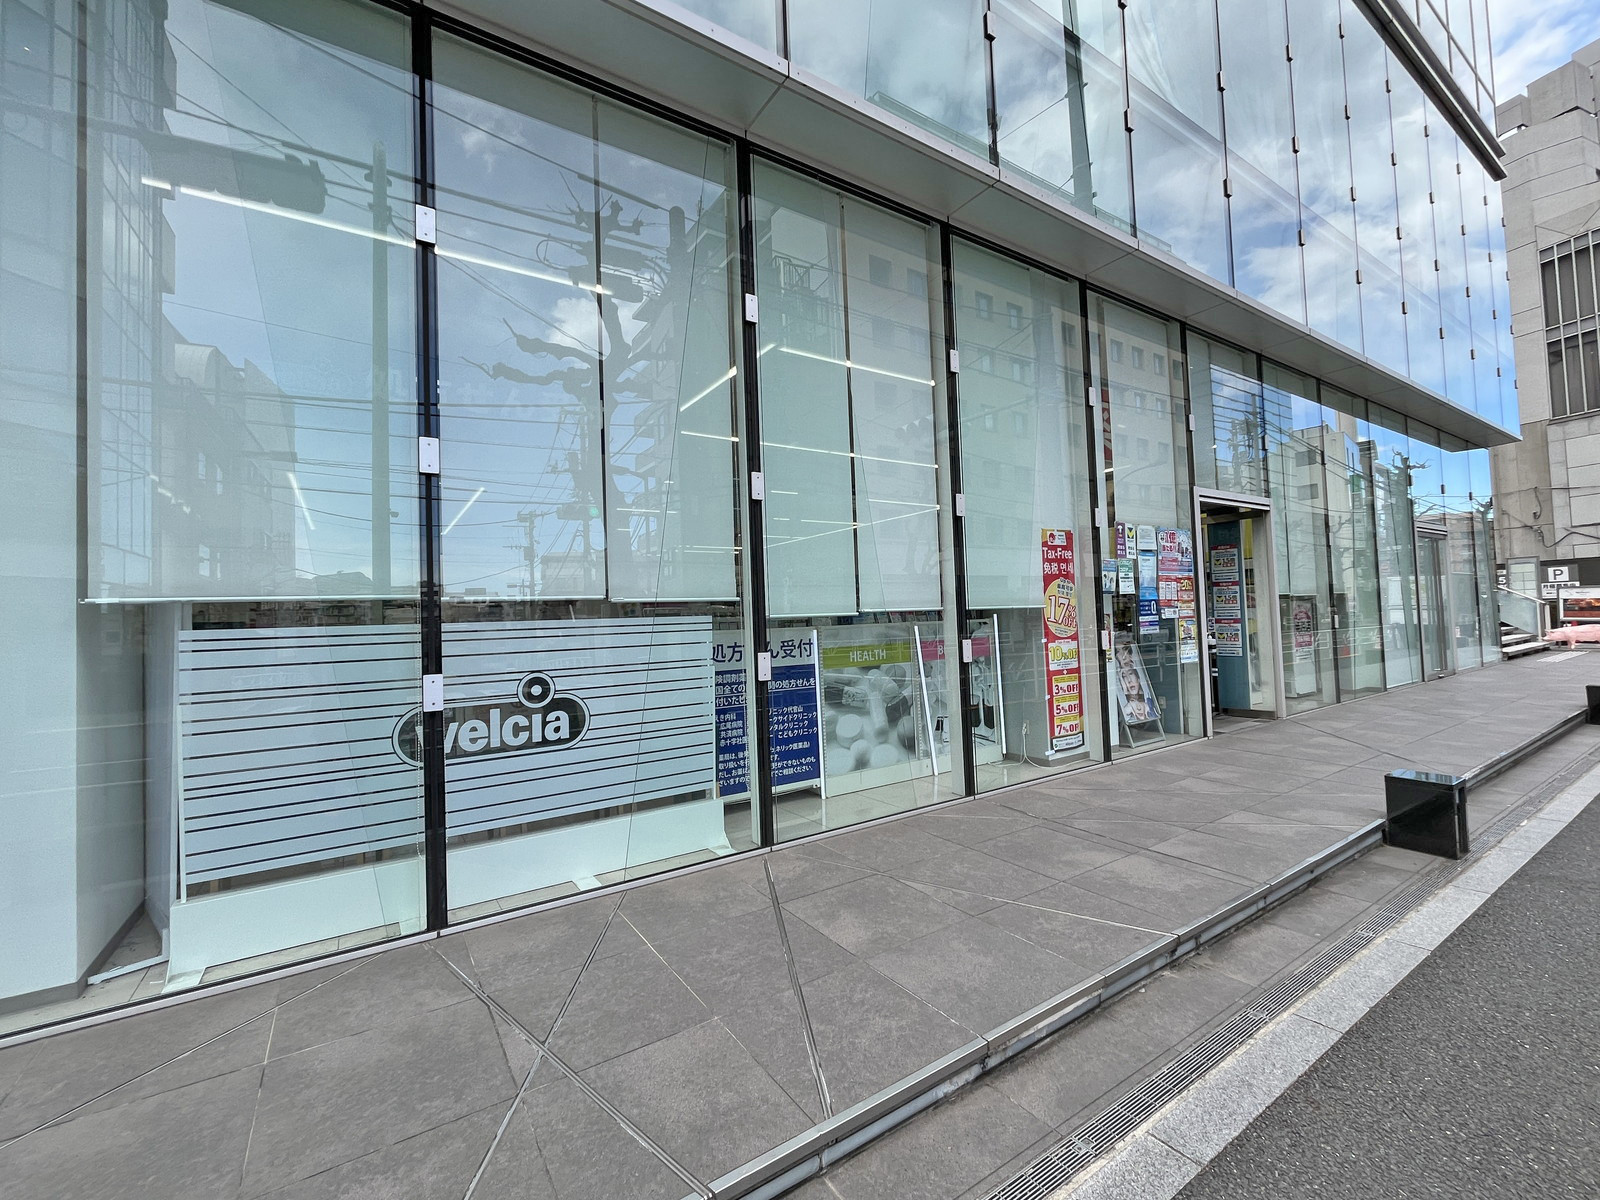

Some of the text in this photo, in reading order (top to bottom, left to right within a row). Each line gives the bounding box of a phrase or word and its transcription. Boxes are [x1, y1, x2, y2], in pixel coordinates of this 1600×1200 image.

[1042, 547, 1073, 559] Tax-Free
[1044, 562, 1059, 574] 免税
[1553, 569, 1564, 580] P
[850, 649, 886, 662] HEALTH
